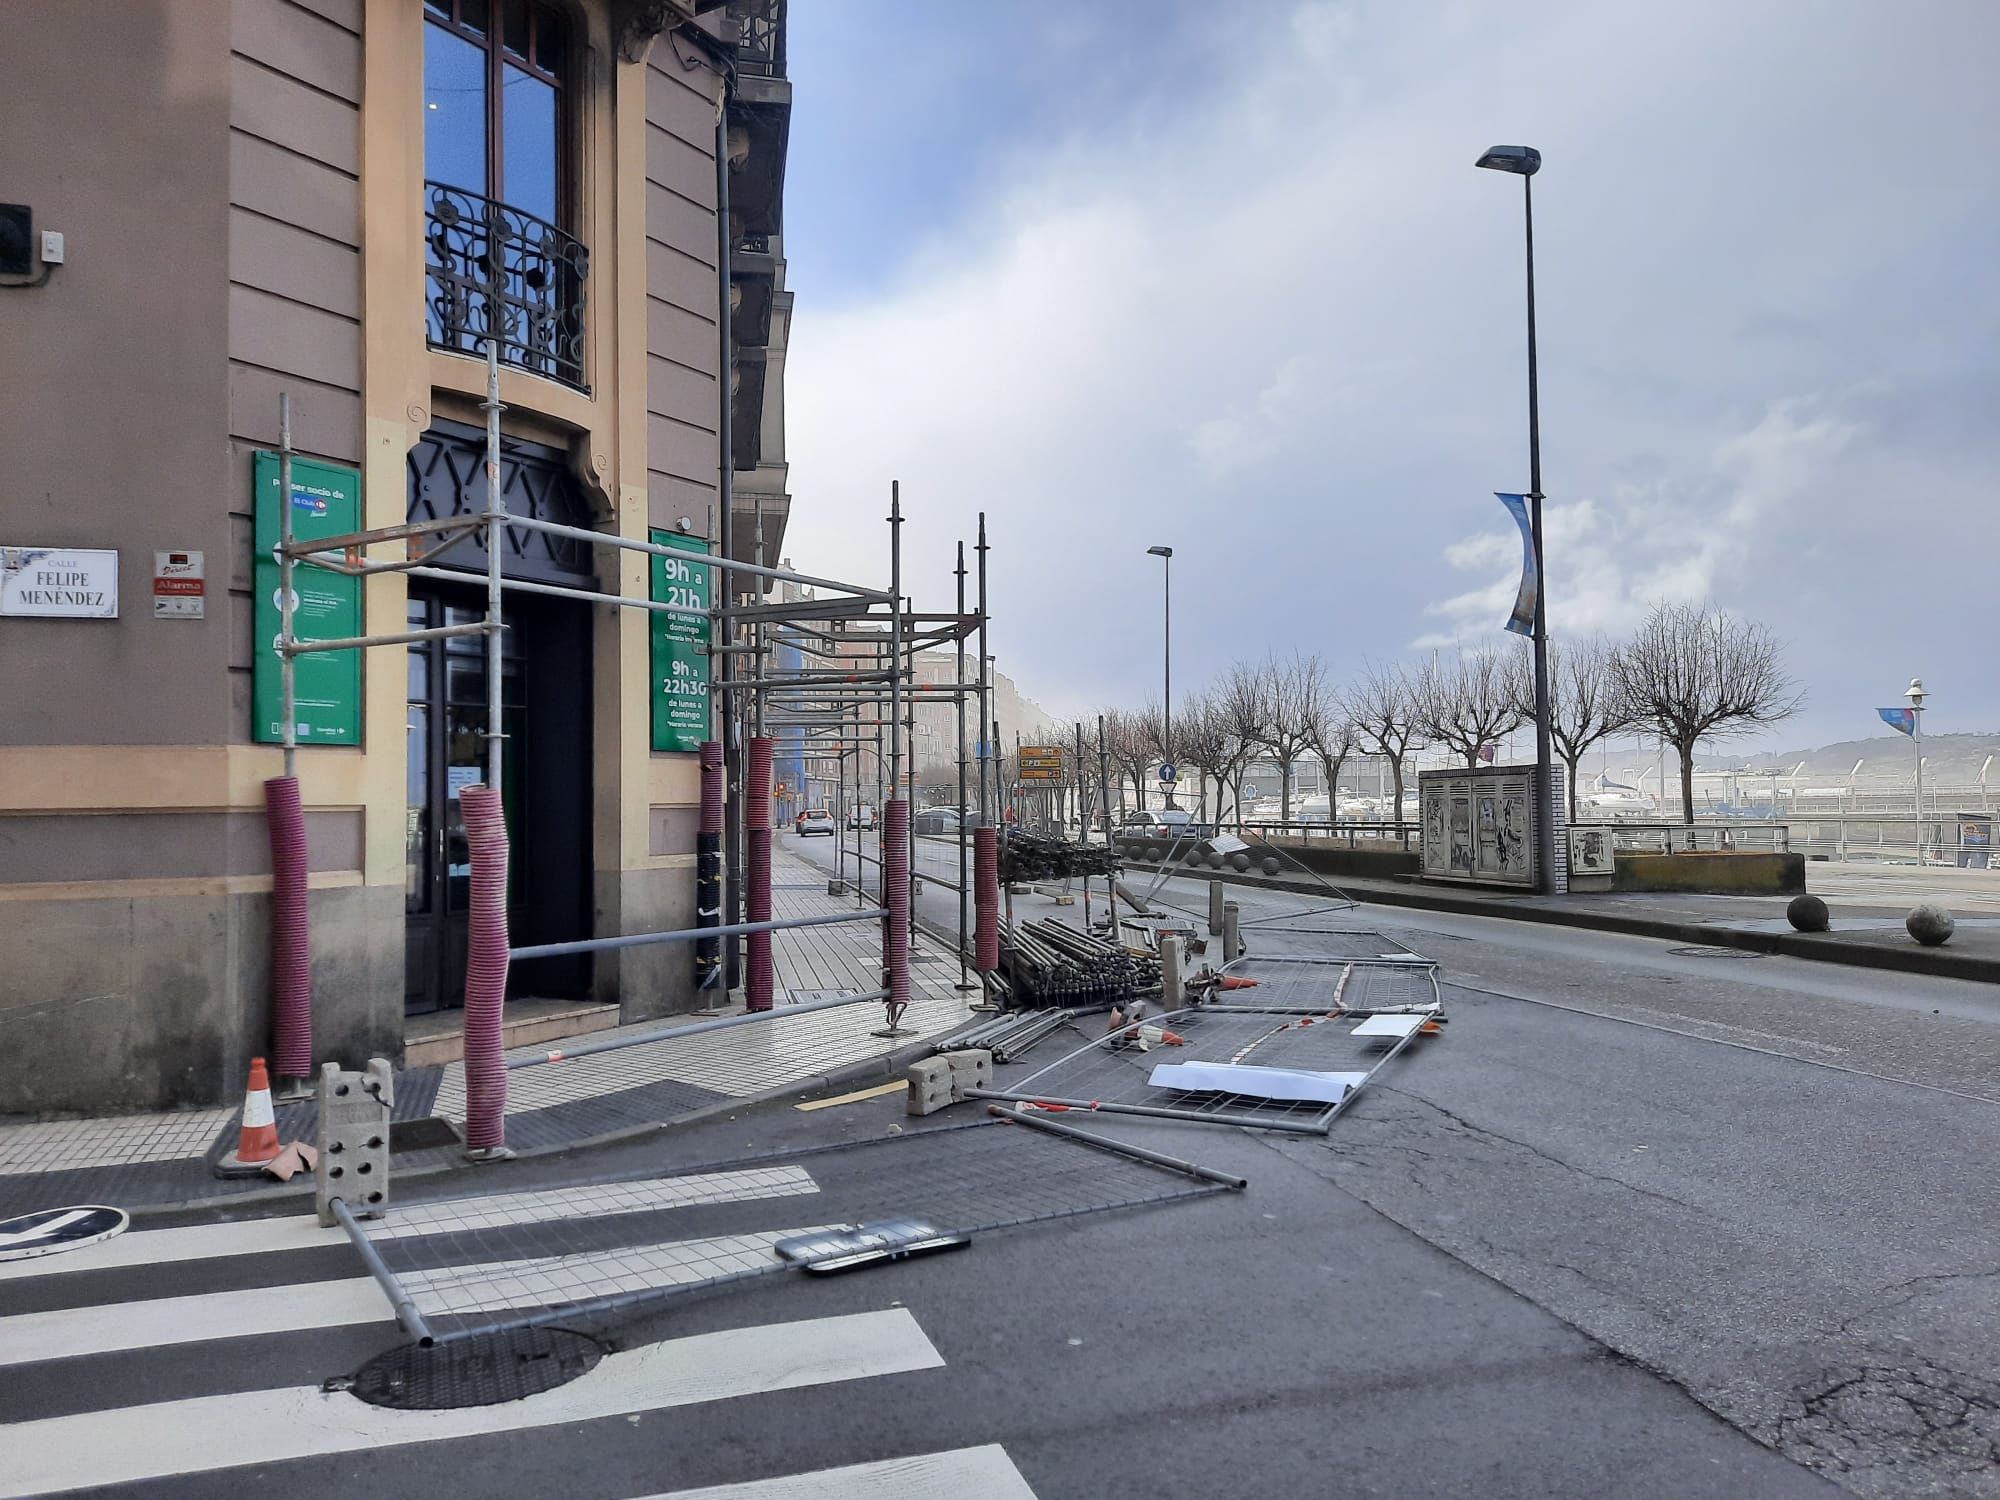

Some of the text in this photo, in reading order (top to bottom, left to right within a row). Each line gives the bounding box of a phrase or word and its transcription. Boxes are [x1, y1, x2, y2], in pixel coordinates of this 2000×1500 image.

[307, 486, 331, 497] socio
[332, 490, 345, 499] de
[48, 560, 77, 568] CALLE
[665, 558, 702, 585] 9h a
[37, 571, 89, 587] FELIPE
[159, 579, 200, 589] Alarma
[20, 587, 105, 606] MENÉNDEZ
[667, 586, 701, 609] 21h
[667, 612, 676, 620] de
[677, 613, 696, 623] lunes
[669, 623, 700, 635] domingo
[672, 660, 698, 677] 9h a
[664, 679, 707, 696] 22h30
[668, 699, 677, 707] de
[678, 699, 696, 708] lunes
[670, 710, 701, 720] domingo
